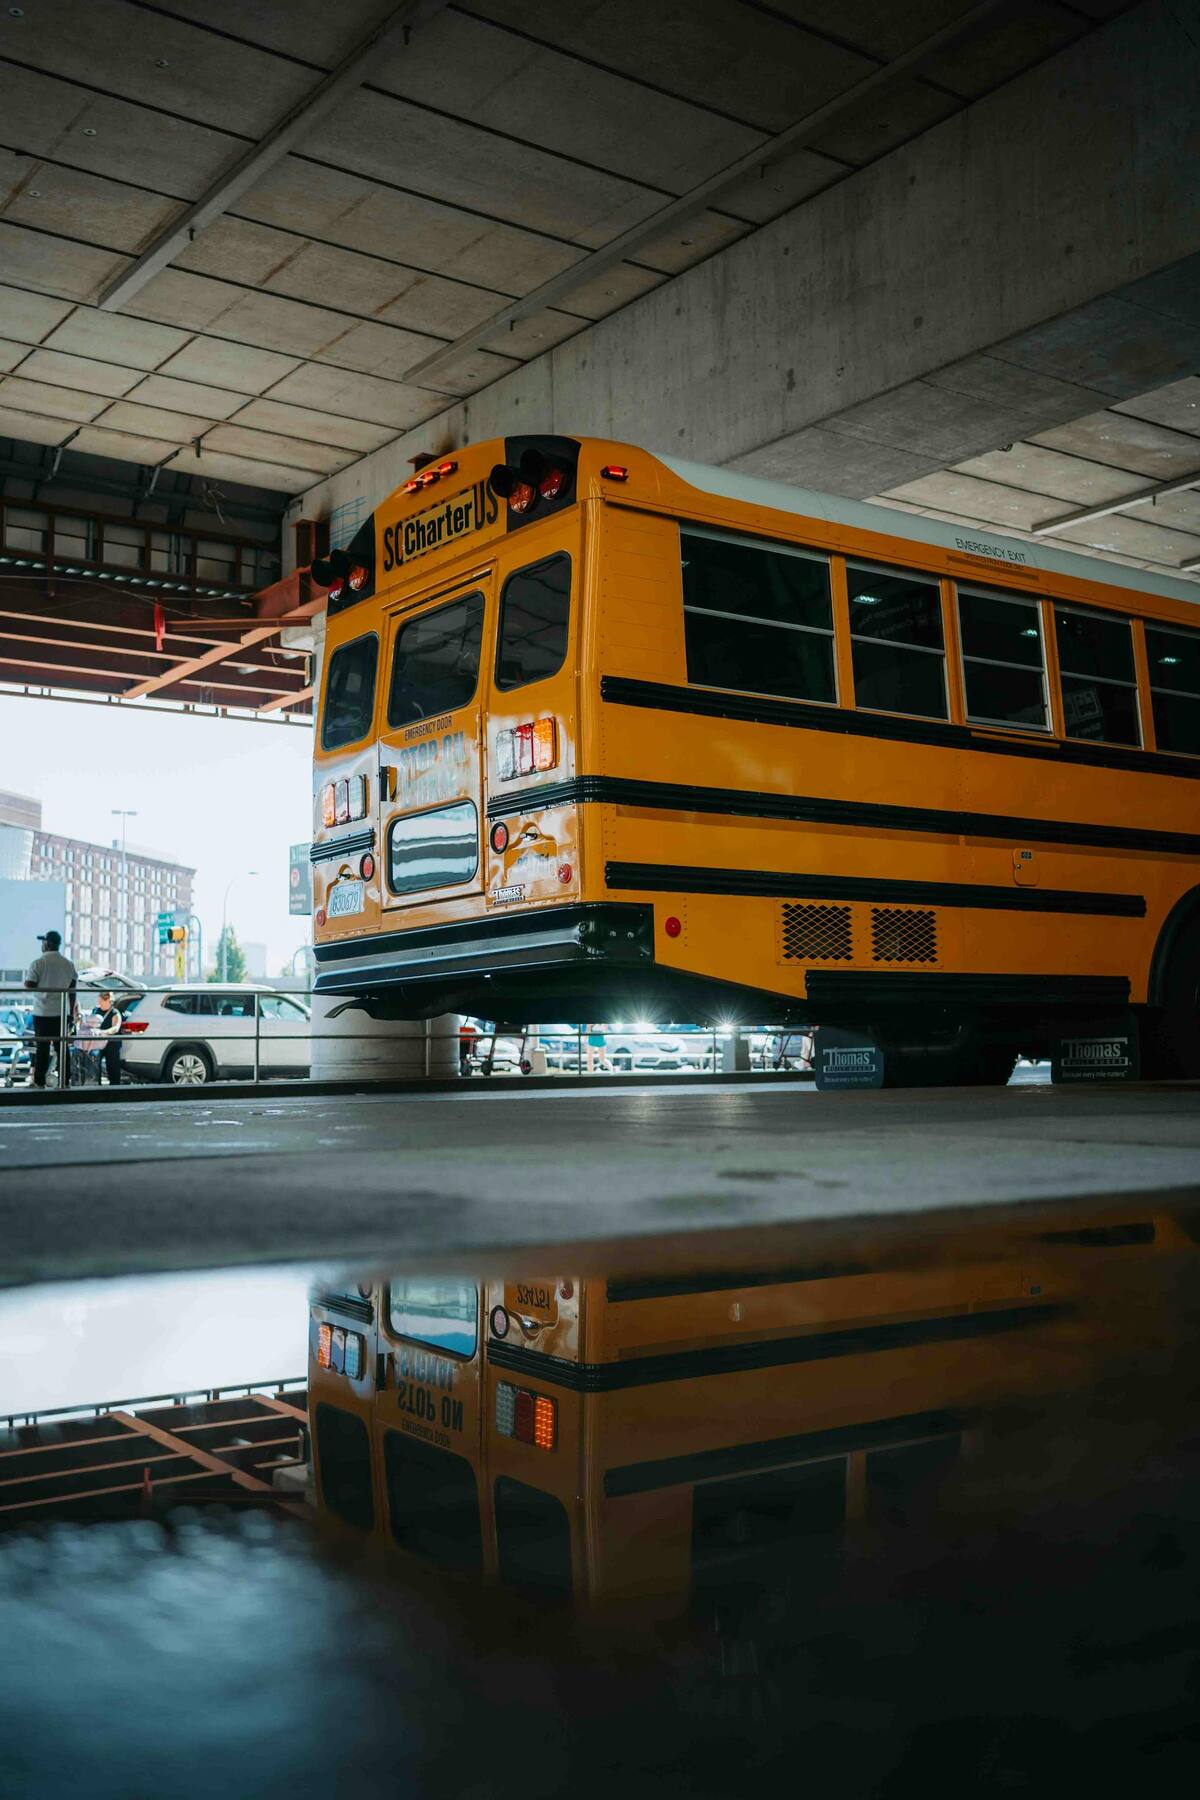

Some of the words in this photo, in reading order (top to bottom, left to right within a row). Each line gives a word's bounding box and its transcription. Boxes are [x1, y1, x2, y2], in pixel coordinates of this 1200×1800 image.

[404, 501, 472, 556] Charter
[955, 538, 1005, 558] EMERGENCY
[1007, 550, 1026, 563] EXIT
[404, 721, 436, 742] EMERGENCY
[437, 716, 453, 731] DOOR
[823, 1047, 876, 1066] Thomas
[1061, 1037, 1128, 1059] Thomas
